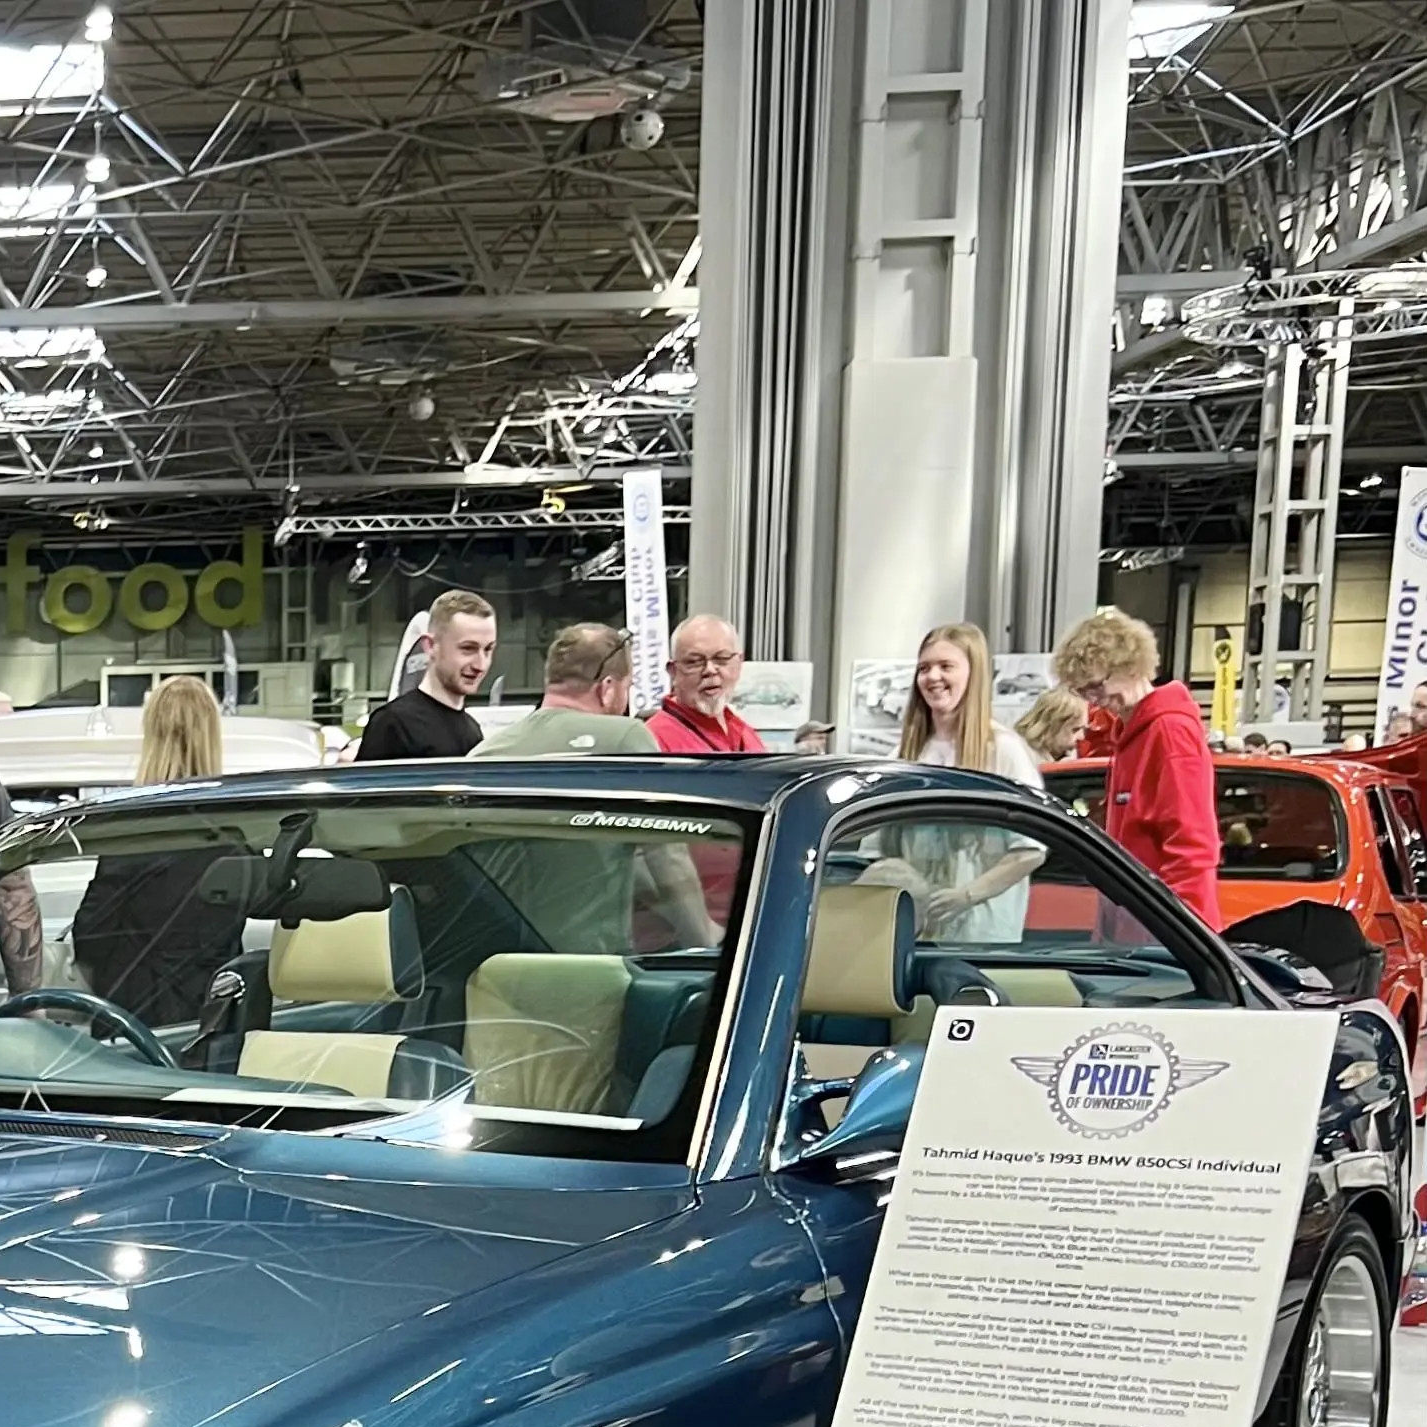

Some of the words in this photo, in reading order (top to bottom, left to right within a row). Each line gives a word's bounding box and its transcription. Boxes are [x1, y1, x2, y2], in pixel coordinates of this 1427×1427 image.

[1385, 579, 1420, 688] Minor
[1068, 1063, 1161, 1097] PRIDE
[1066, 1096, 1082, 1109] OF
[1083, 1097, 1153, 1111] OWNERSHIP
[922, 1147, 978, 1161] Tahmid
[982, 1149, 1045, 1166] Haque's
[1049, 1152, 1083, 1165] 1993
[1087, 1153, 1133, 1167] BMW
[1136, 1154, 1194, 1171] 850CSi
[1196, 1158, 1281, 1174] Individual
